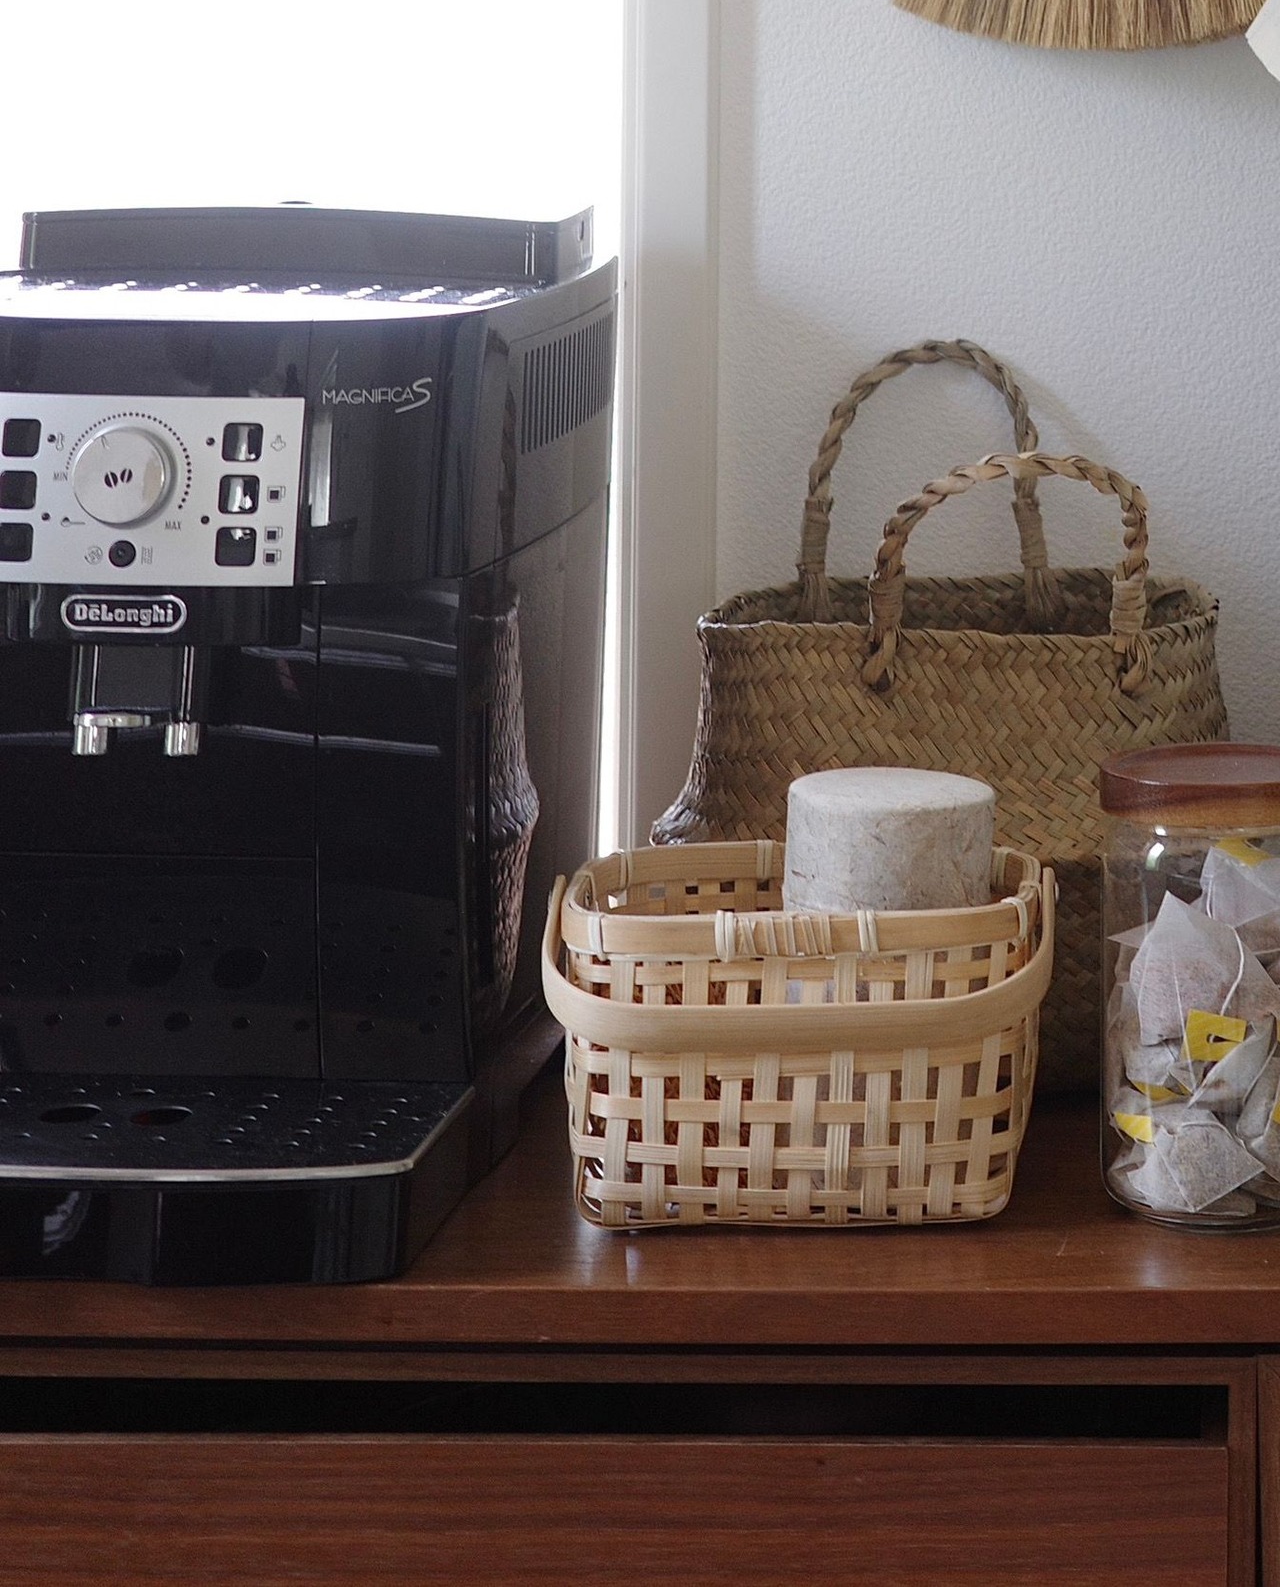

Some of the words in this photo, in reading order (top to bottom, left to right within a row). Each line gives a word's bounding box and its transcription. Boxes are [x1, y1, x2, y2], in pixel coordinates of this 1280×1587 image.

[322, 387, 415, 405] MAGNIFICA
[53, 471, 69, 482] MIN
[164, 520, 182, 531] MAX
